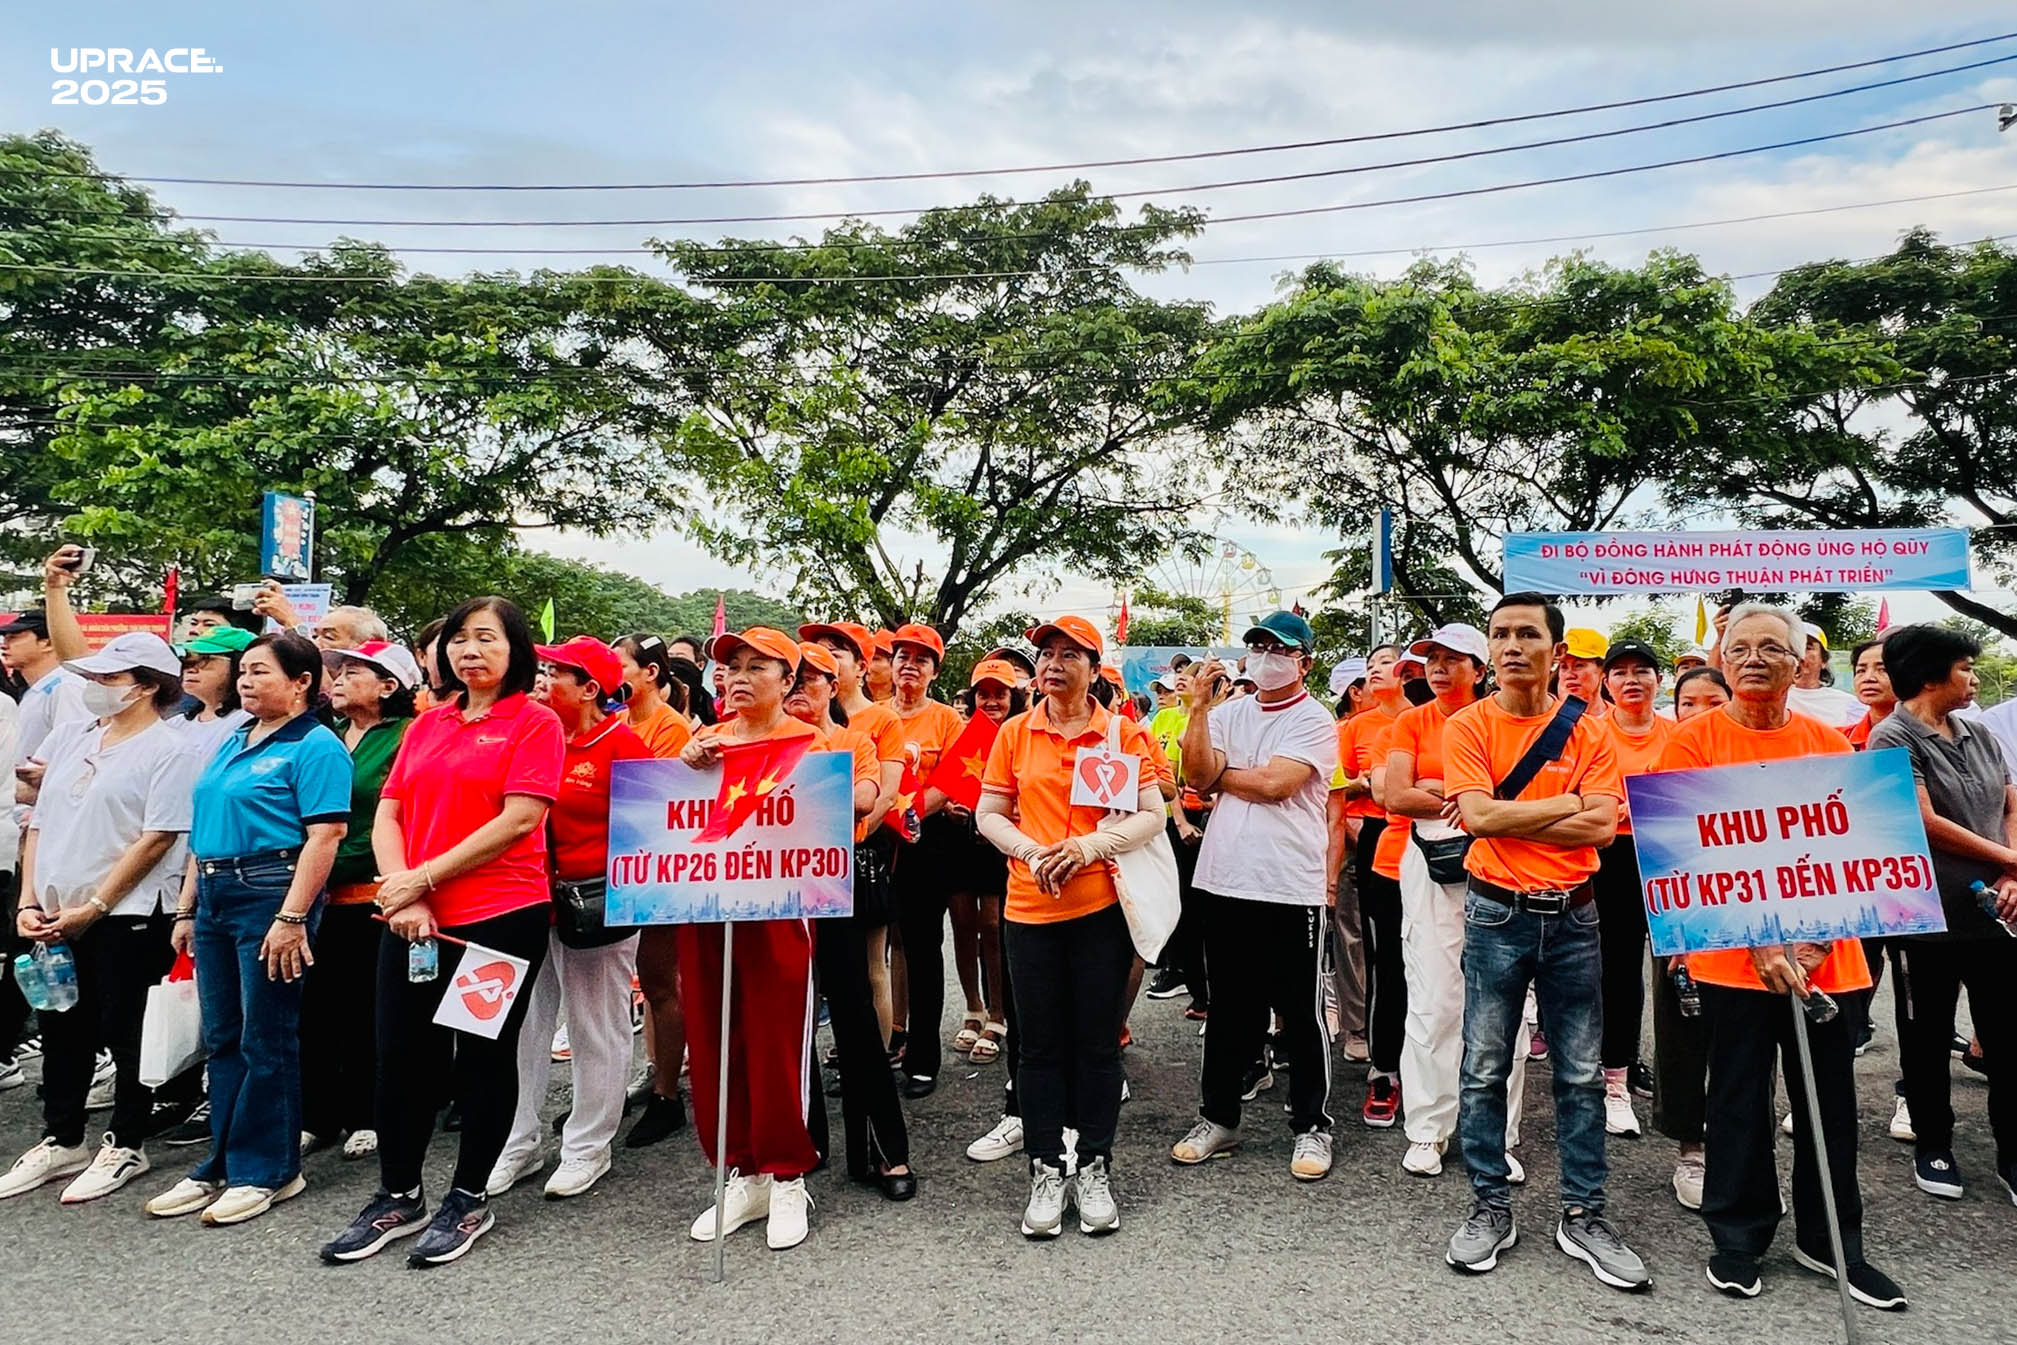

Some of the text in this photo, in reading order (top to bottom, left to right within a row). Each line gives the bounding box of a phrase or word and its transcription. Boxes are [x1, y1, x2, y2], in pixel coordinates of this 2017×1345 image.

[1541, 537, 1929, 562] ĐI BỘ ĐỒNG HÀNH PHÁT ĐỘNG ỦNG HỘ QŨY
[1612, 568, 1664, 585] ĐÔNG
[1671, 571, 1720, 584] HƯNG
[1727, 567, 1783, 587] THUẬN
[1790, 566, 1832, 583] PHÁT
[667, 784, 797, 830] KH HỐ
[1697, 788, 1849, 847] KHU PHỐ
[611, 841, 848, 887] (TỪ KP26 ĐẾN KP30)
[1645, 853, 1933, 915] (TỪ KP31 ĐẾN KP35)
